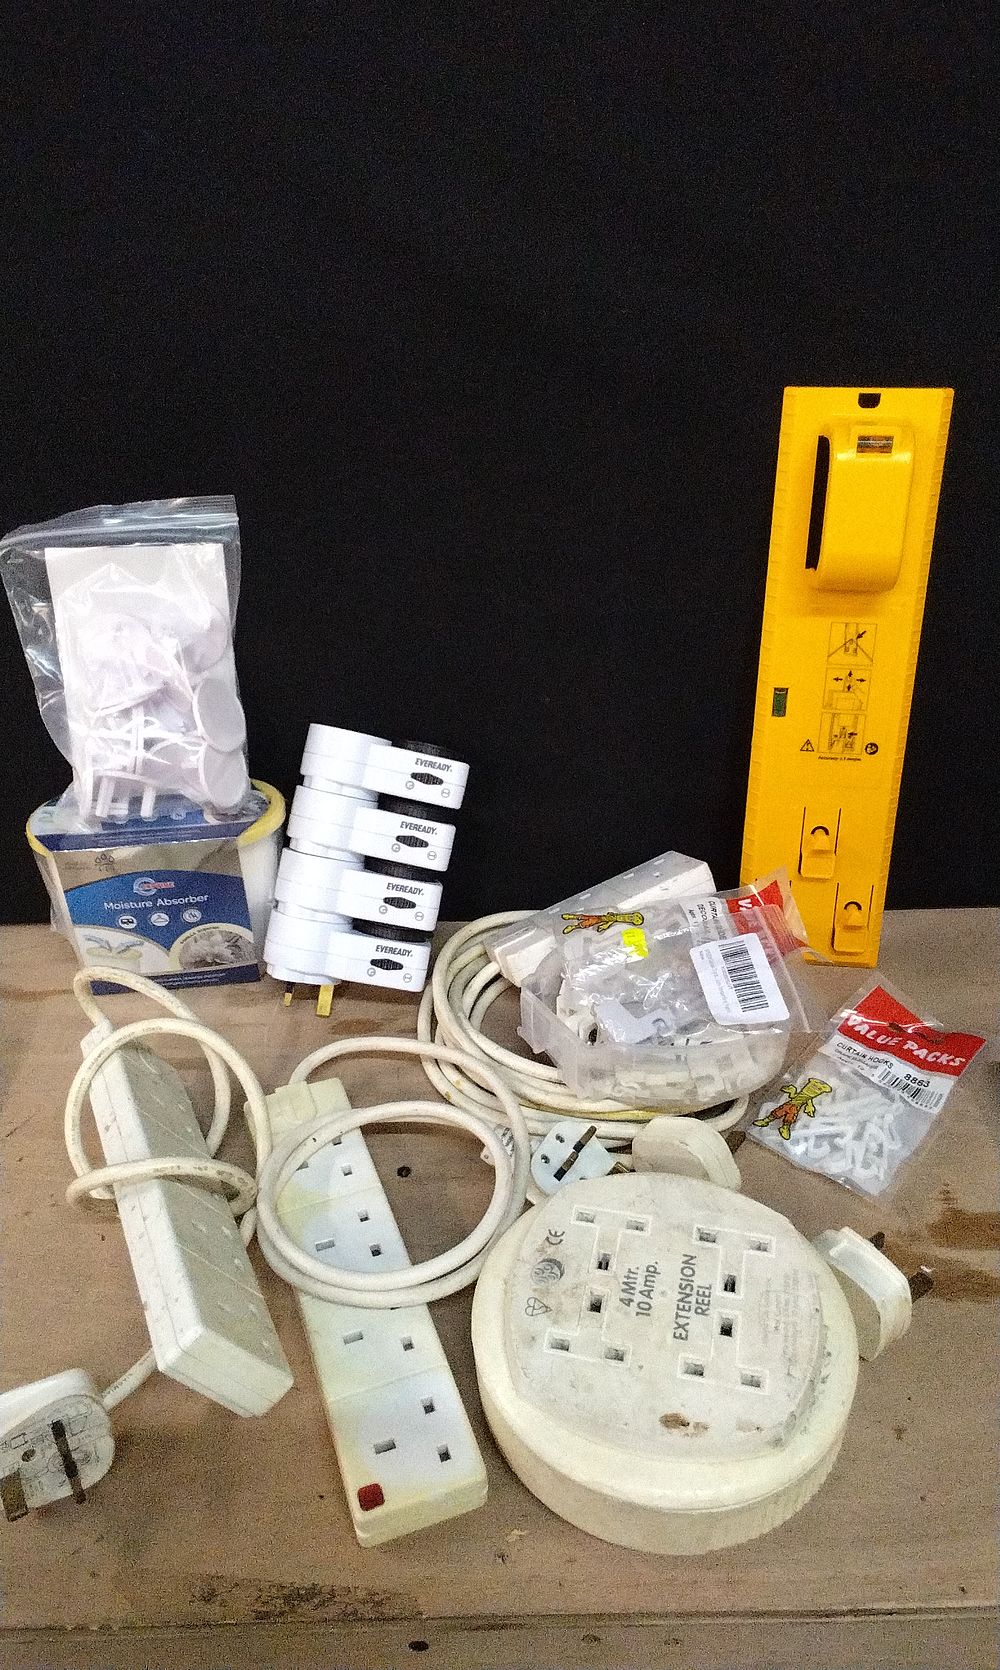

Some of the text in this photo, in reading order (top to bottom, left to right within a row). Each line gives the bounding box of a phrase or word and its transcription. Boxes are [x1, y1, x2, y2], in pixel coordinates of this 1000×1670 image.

[414, 757, 452, 772] EVEREADY
[400, 821, 438, 835] EVEREADY
[386, 882, 424, 896] EVEREADY
[103, 894, 209, 910] Moisture Absorber
[375, 944, 413, 957] EVEREADY
[847, 1014, 966, 1067] VALUE PACKS
[836, 1042, 868, 1059] CURTAIN
[867, 1055, 894, 1069] HOOKS
[903, 1073, 931, 1089] 8863
[619, 1266, 640, 1308] 4 Mtr.
[635, 1260, 661, 1317] 10 Amp.
[672, 1253, 697, 1342] EXTENSION
[694, 1283, 712, 1317] REEL
